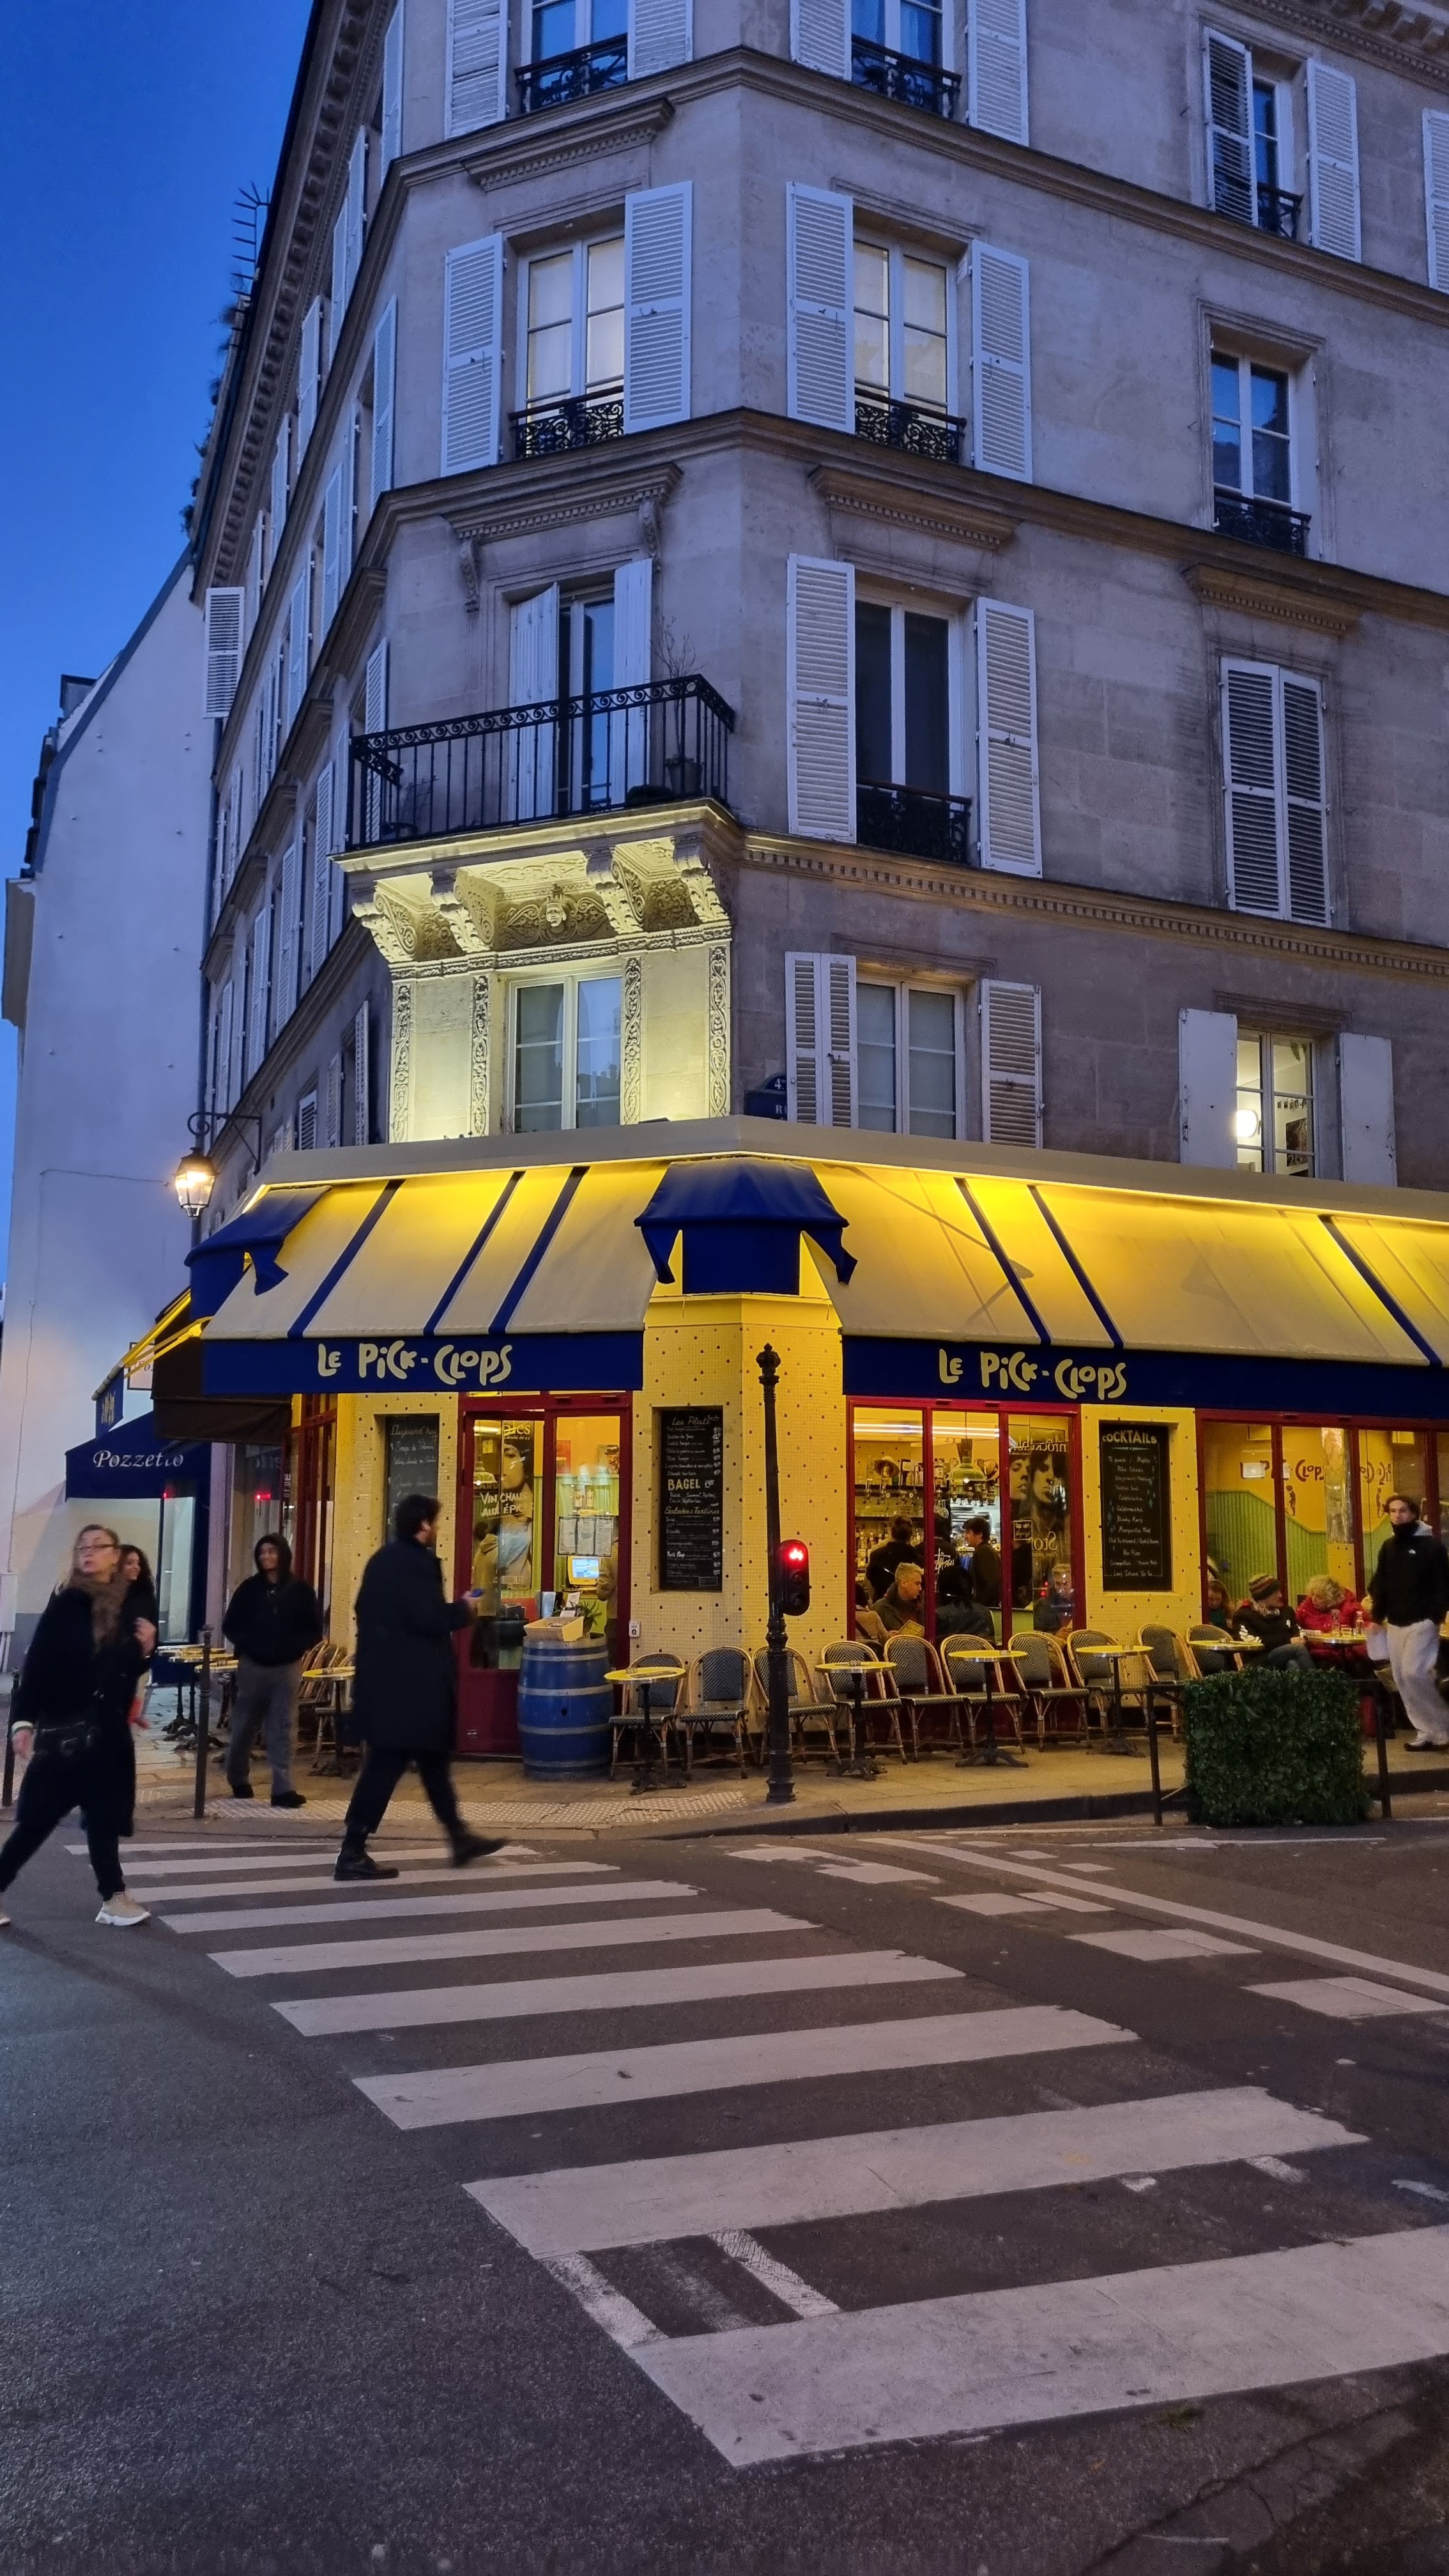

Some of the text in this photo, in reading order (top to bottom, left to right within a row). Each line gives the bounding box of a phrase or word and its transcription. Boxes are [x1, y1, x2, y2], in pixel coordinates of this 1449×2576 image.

[318, 1344, 341, 1377] LE
[939, 1348, 963, 1384] LE
[672, 1416, 684, 1425] Les
[668, 1478, 701, 1491] BAGEL
[480, 1492, 522, 1505] VIN CHAU
[664, 1506, 689, 1515] Salades
[694, 1506, 720, 1515] Tartines
